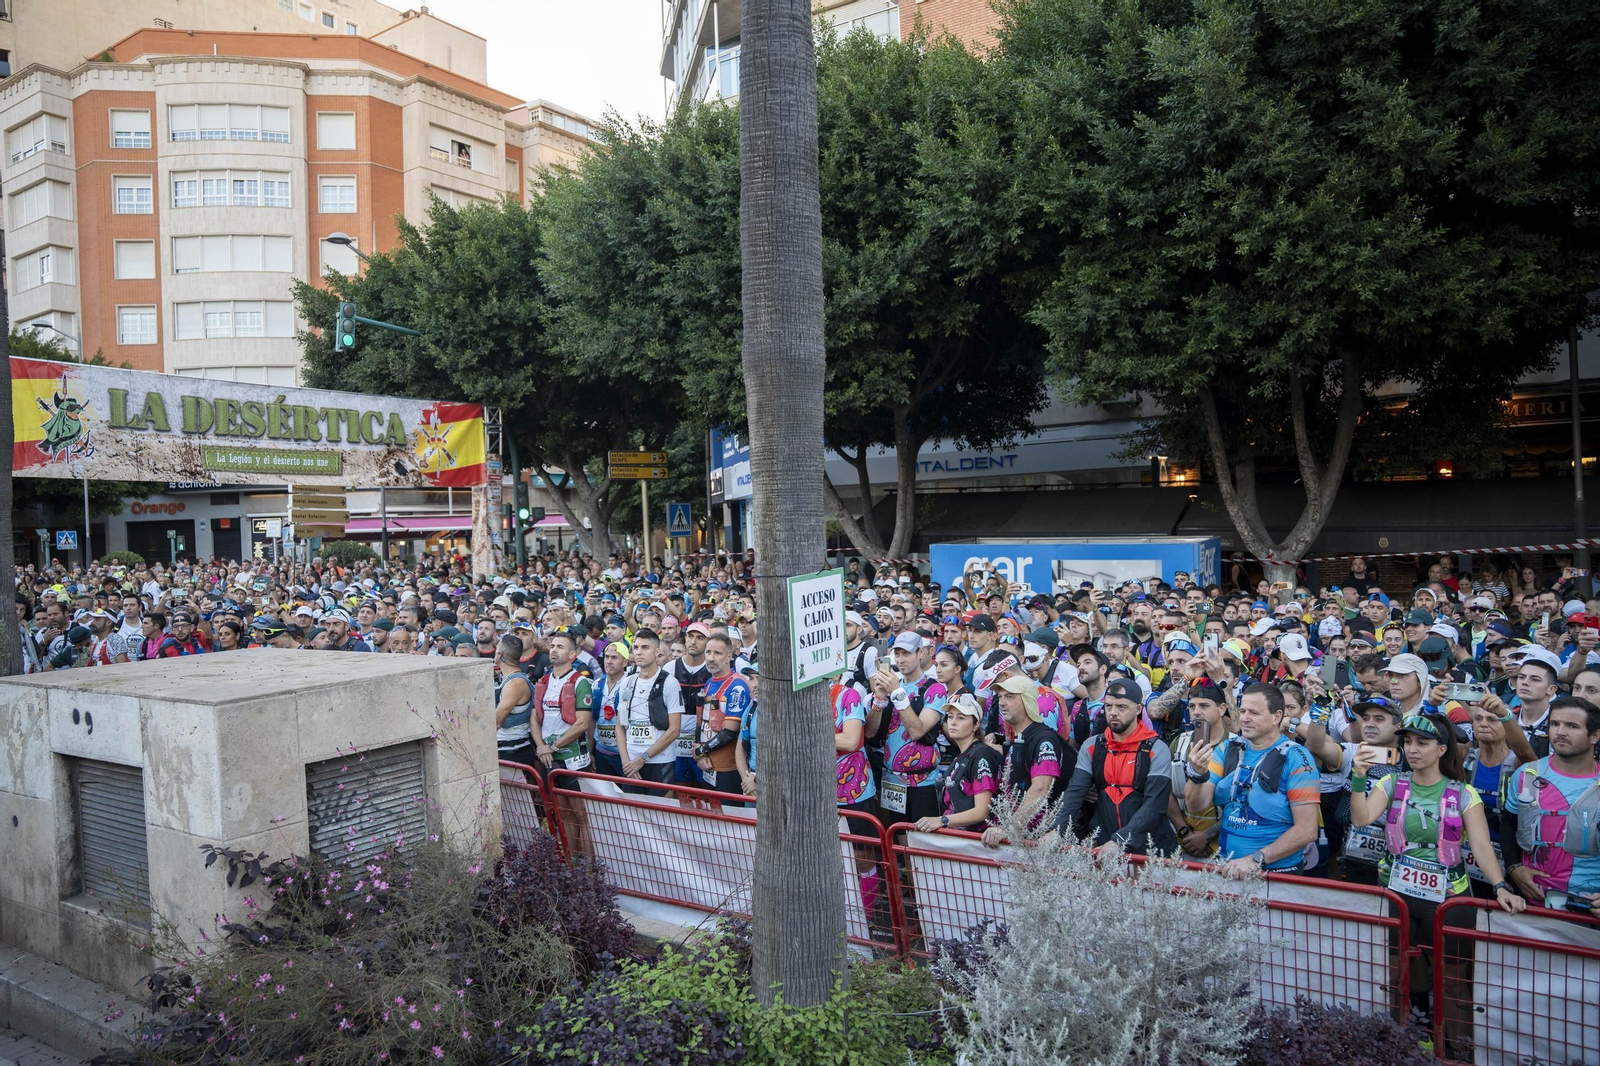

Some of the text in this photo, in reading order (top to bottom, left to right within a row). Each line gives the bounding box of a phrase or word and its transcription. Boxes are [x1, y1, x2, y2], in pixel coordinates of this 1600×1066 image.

[108, 388, 407, 446] LA DESÉRTICA
[216, 454, 225, 463] La
[229, 455, 252, 466] Legión
[264, 455, 270, 465] el
[273, 456, 300, 467] desierto
[303, 458, 314, 467] nos
[317, 459, 328, 467] une
[915, 455, 1018, 473] ITALDENT
[131, 501, 186, 515] Orange
[800, 588, 836, 609] ACCESO
[804, 606, 834, 628] CAJÓN
[799, 625, 839, 649] SALIDA 1
[812, 646, 830, 664] MTB
[601, 731, 616, 739] 4464
[632, 727, 650, 737] 2076
[678, 741, 696, 750] 463
[887, 791, 903, 804] 4046
[1402, 867, 1439, 889] 2198
